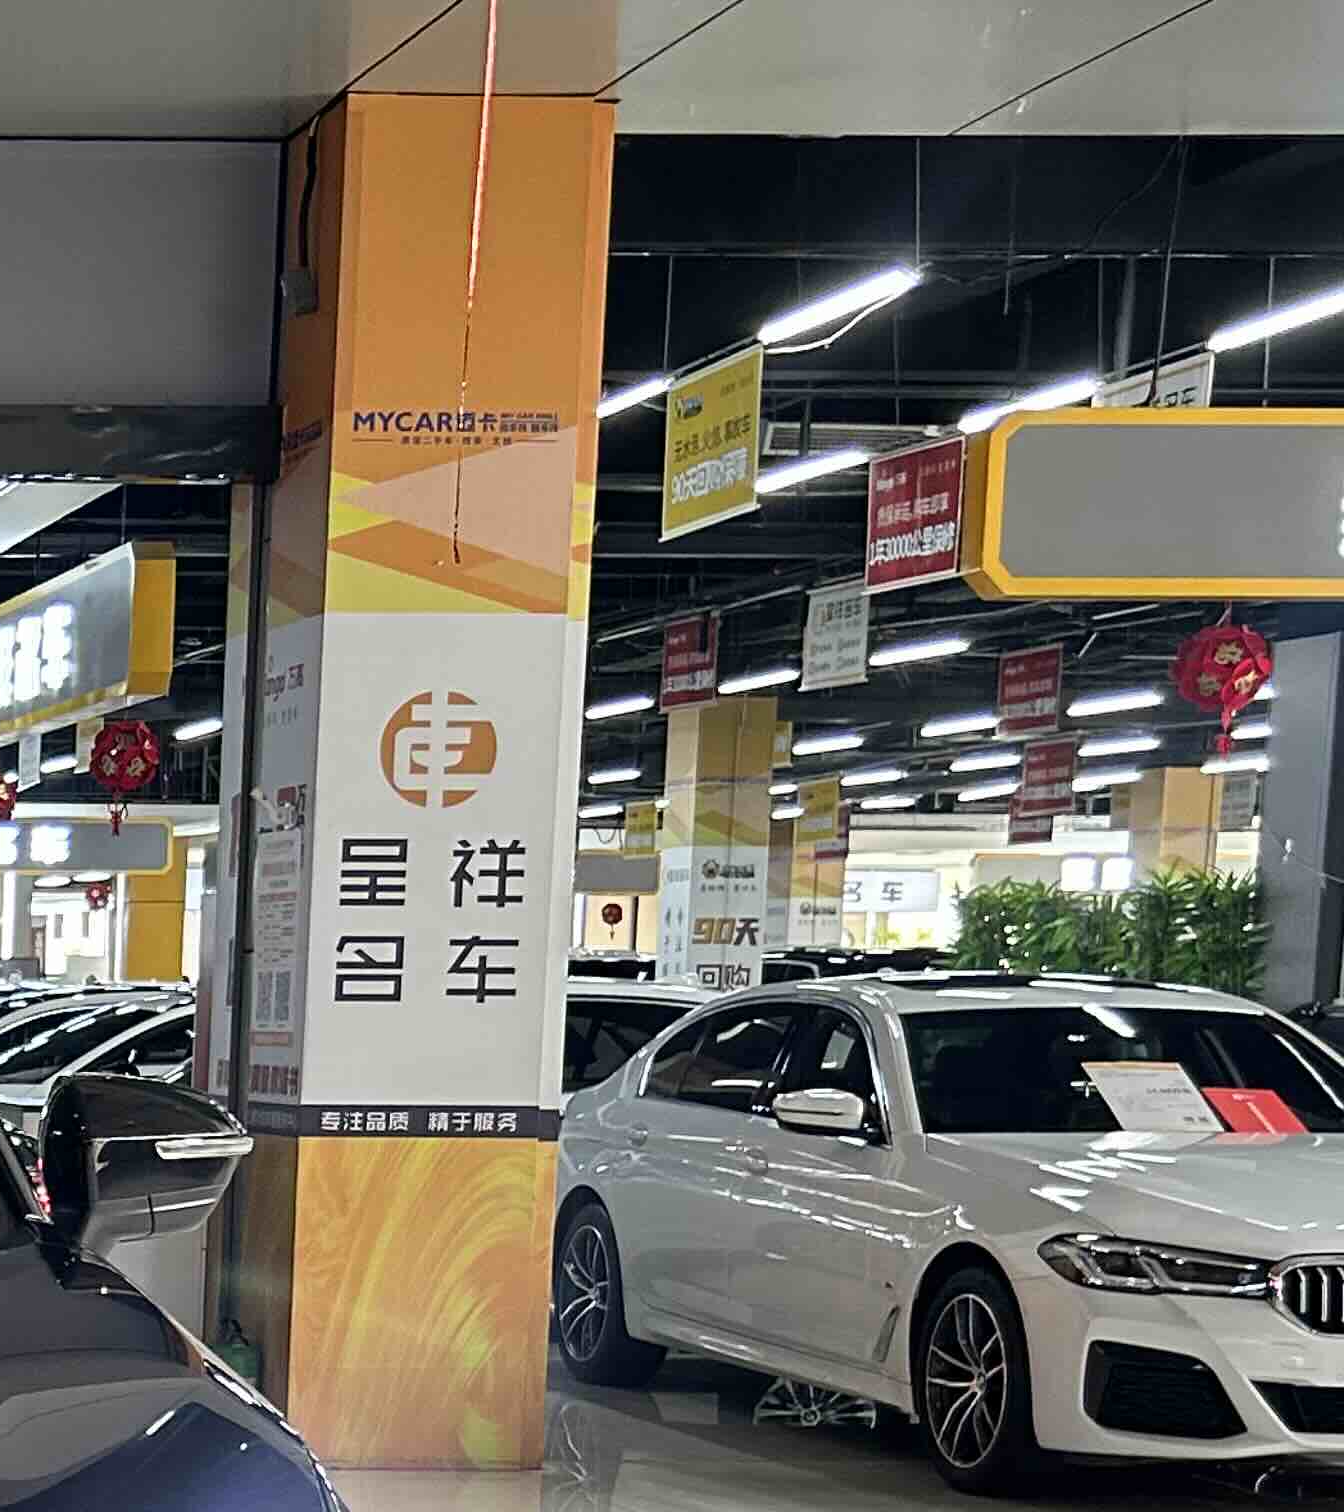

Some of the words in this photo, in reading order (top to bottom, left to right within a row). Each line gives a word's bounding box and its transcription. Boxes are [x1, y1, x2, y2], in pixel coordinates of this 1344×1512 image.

[339, 838, 527, 907] 呈祥
[692, 917, 760, 946] 90天
[333, 935, 520, 1004] 名车
[320, 1111, 410, 1133] 专注品质
[427, 1112, 519, 1134] 精于服务
